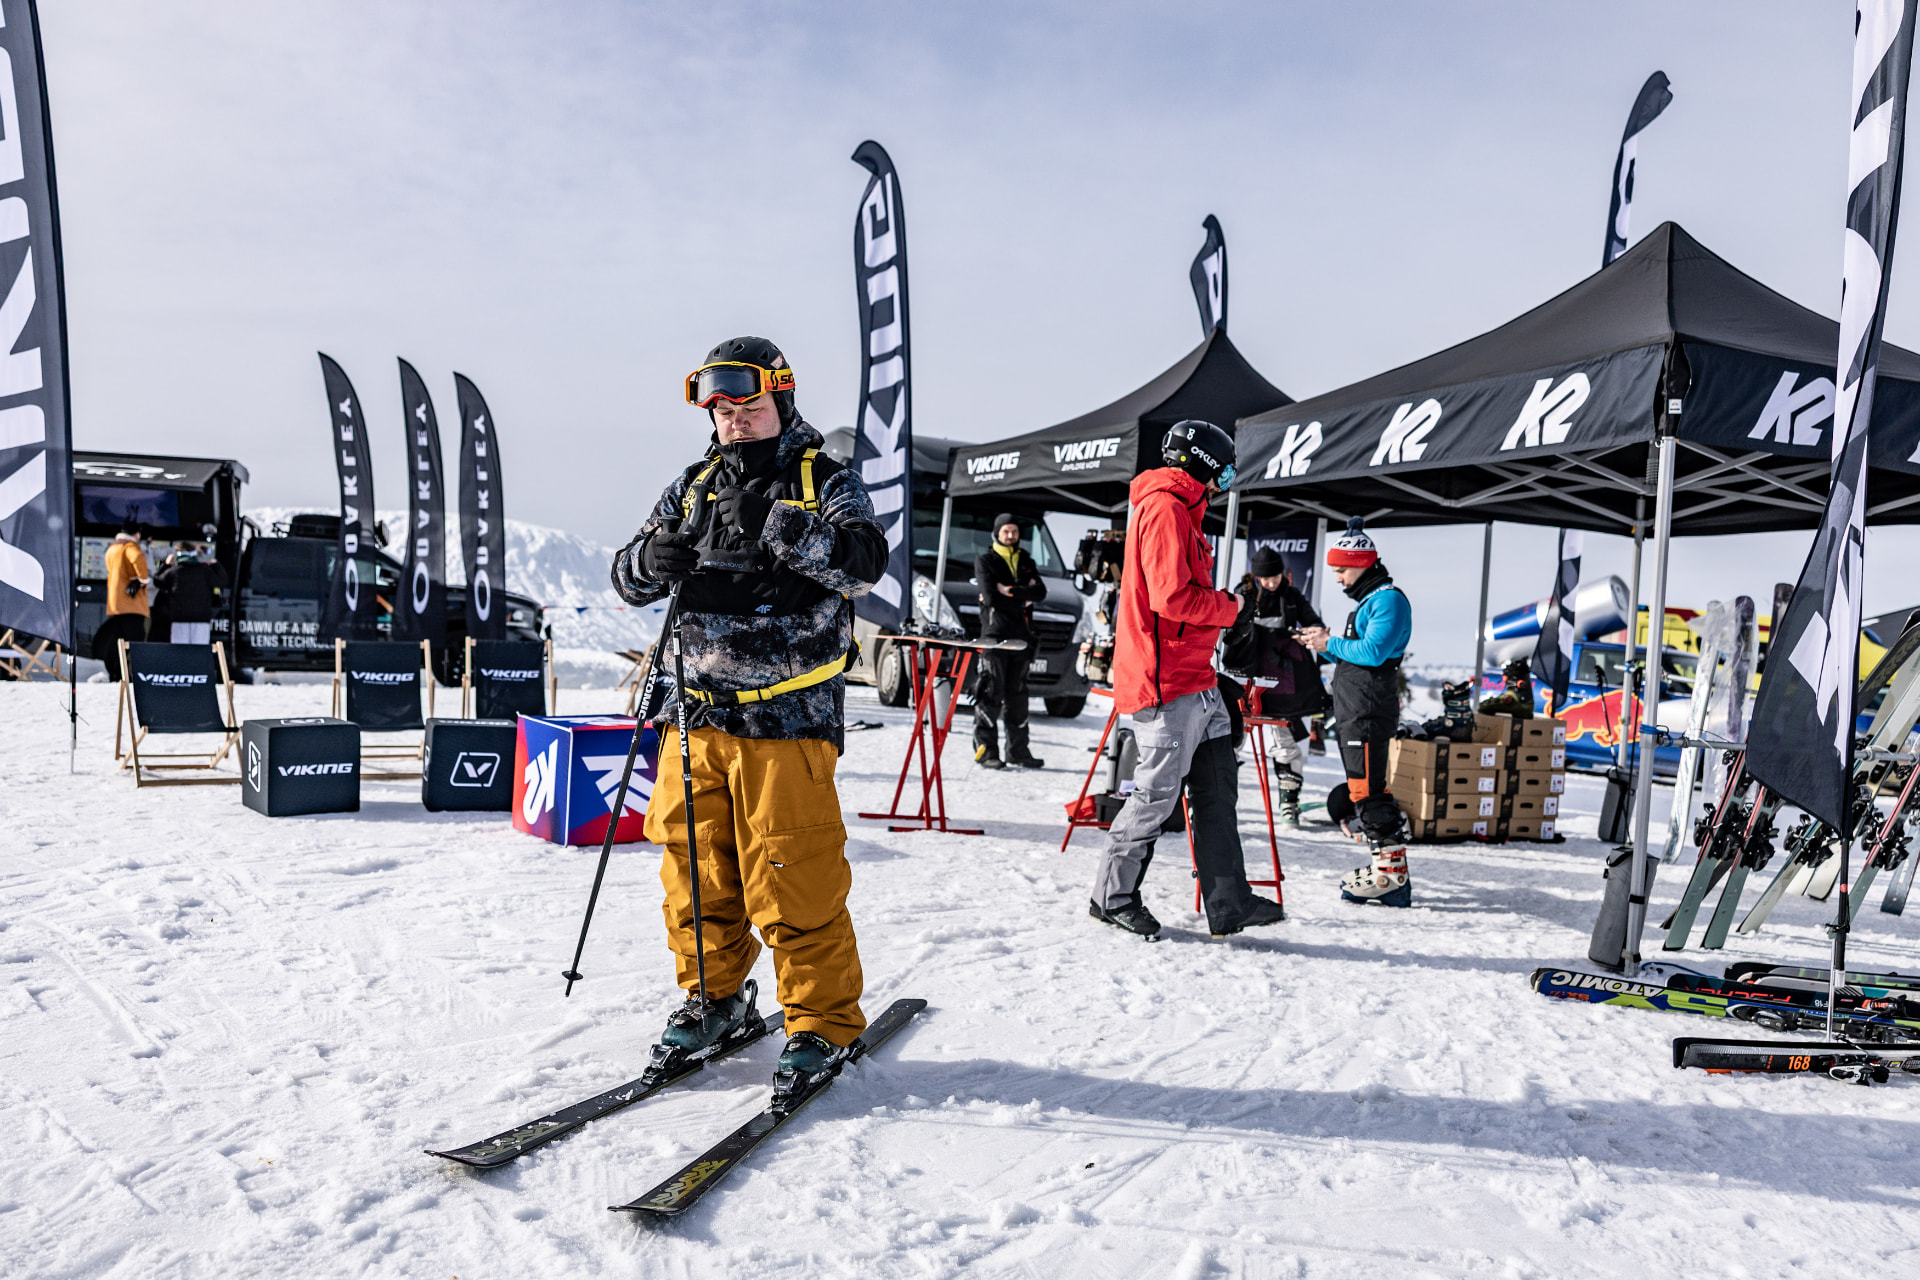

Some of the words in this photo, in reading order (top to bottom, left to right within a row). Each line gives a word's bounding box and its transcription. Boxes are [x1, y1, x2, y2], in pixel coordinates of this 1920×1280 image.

[1500, 372, 1591, 451] K2
[1747, 370, 1835, 446] K2
[1369, 398, 1442, 466] K2
[1053, 437, 1121, 463] VIKING
[1191, 446, 1220, 469] OAKLEY
[1264, 420, 1323, 480] K2
[967, 451, 1021, 475] VIKING
[1254, 539, 1309, 552] VIKING
[755, 604, 773, 614] 4F
[239, 621, 273, 634] DAWN
[275, 622, 288, 634] OF
[291, 622, 300, 635] A
[302, 623, 320, 635] NE
[250, 635, 279, 648] LENS
[137, 672, 208, 684] VIKING
[351, 671, 415, 682] VIKING
[480, 668, 541, 679] VIKING
[638, 665, 658, 720] ATOMIC
[678, 701, 688, 757] ATOMIC
[278, 763, 353, 777] VIKING
[523, 738, 558, 825] K2
[1551, 971, 1665, 998] ATOMIC
[1787, 1056, 1811, 1070] 168
